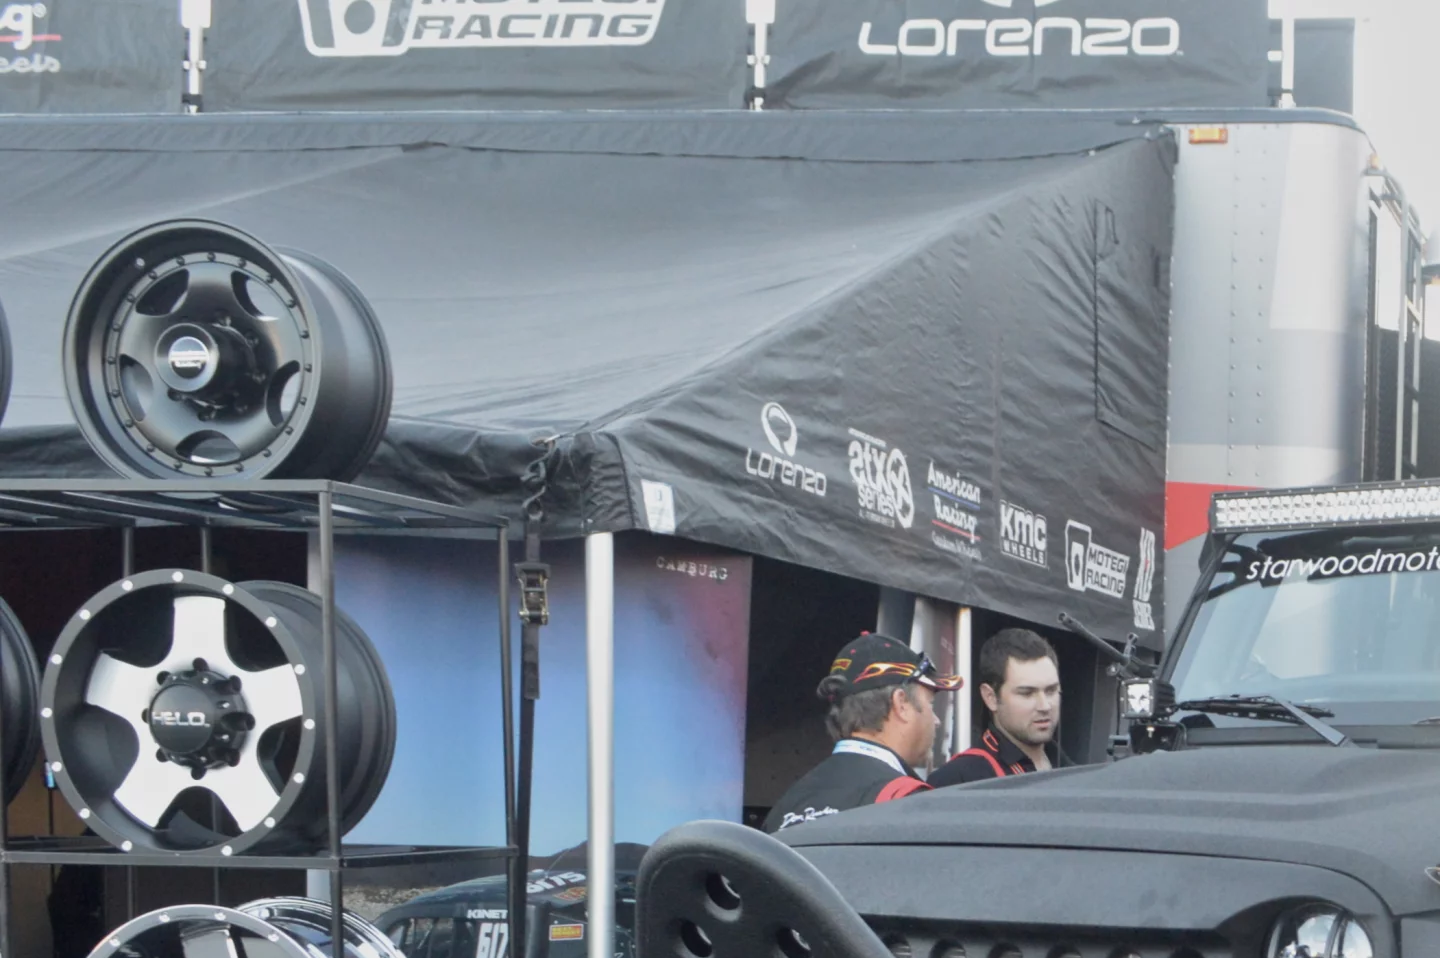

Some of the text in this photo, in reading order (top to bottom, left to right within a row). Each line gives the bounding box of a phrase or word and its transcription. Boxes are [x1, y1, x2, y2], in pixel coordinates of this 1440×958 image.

[412, 14, 653, 40] RACING
[927, 460, 981, 504] American
[933, 494, 978, 544] Racing
[1003, 540, 1045, 565] WHEELS
[1088, 546, 1129, 574] MOTEGI
[1087, 568, 1125, 595] RACING
[152, 711, 206, 726] HELO
[467, 909, 508, 920] KINET
